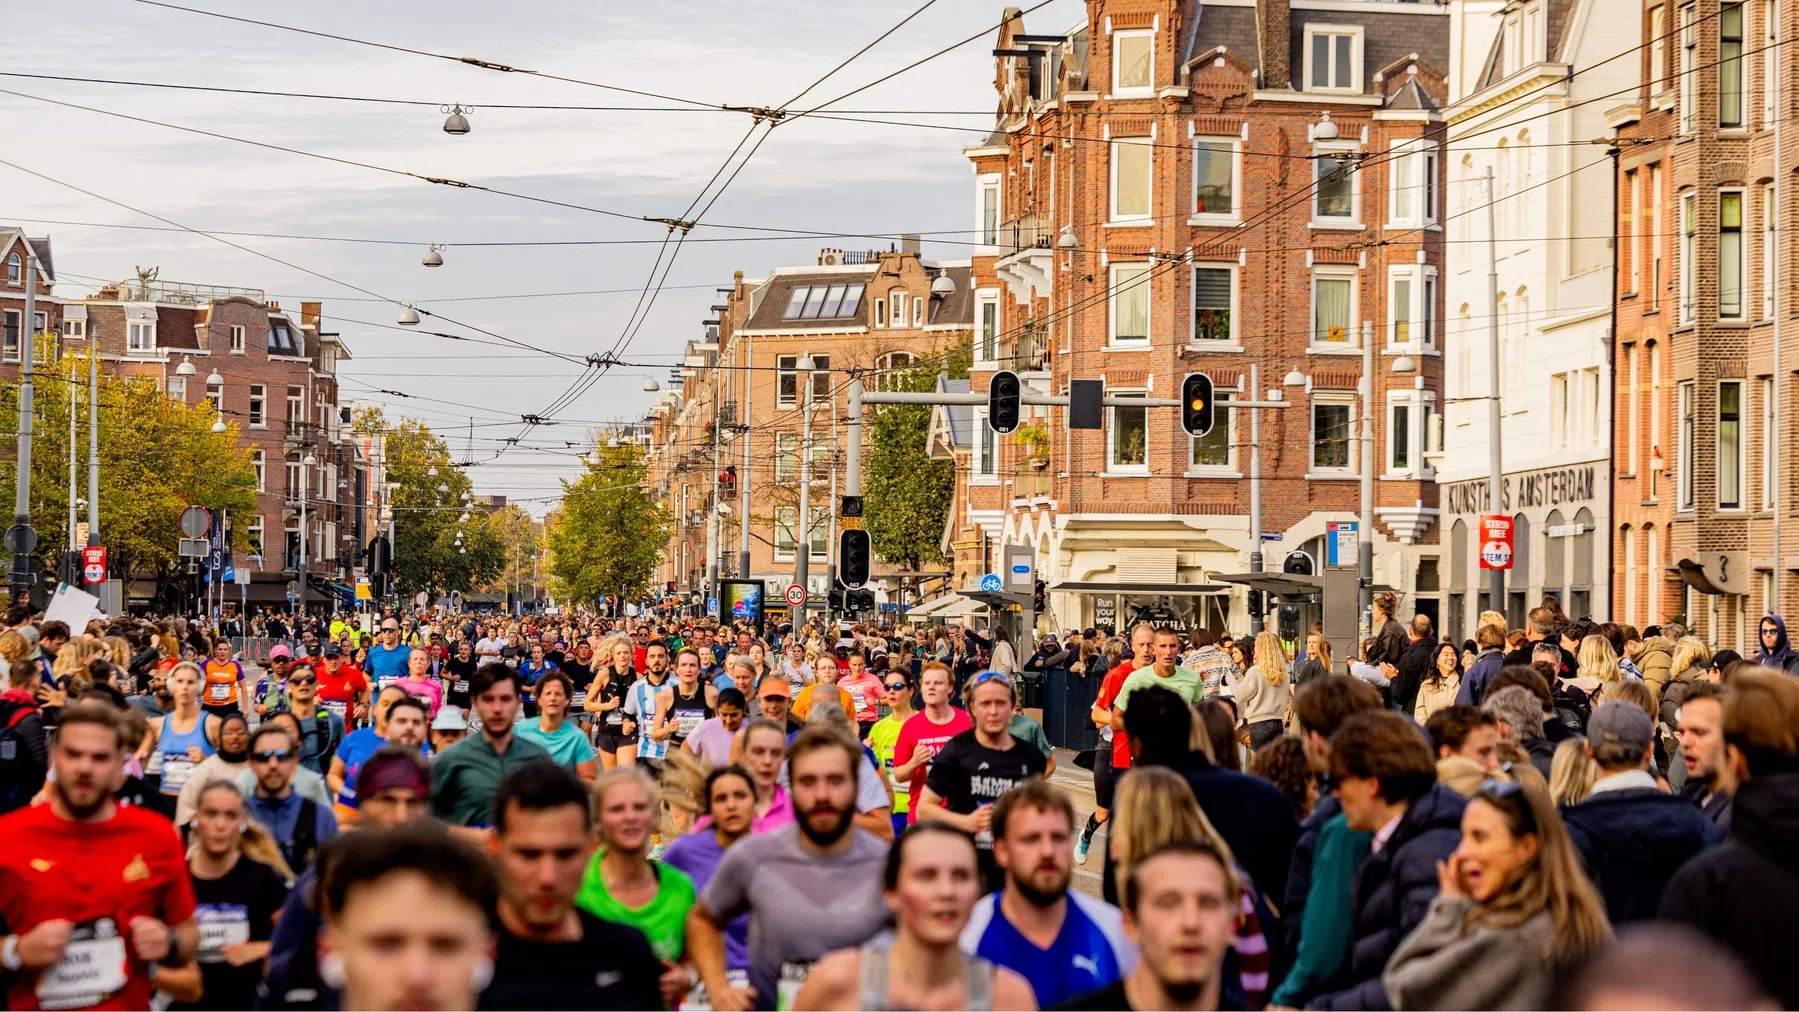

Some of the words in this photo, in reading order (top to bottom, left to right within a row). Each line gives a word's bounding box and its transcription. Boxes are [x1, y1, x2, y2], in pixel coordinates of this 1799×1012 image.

[1448, 477, 1511, 514] KUNSTHS
[1518, 466, 1595, 507] AMSTERDAM
[789, 591, 802, 600] 30
[1097, 599, 1114, 608] Run
[1096, 608, 1115, 617] your
[1095, 617, 1115, 626] way.
